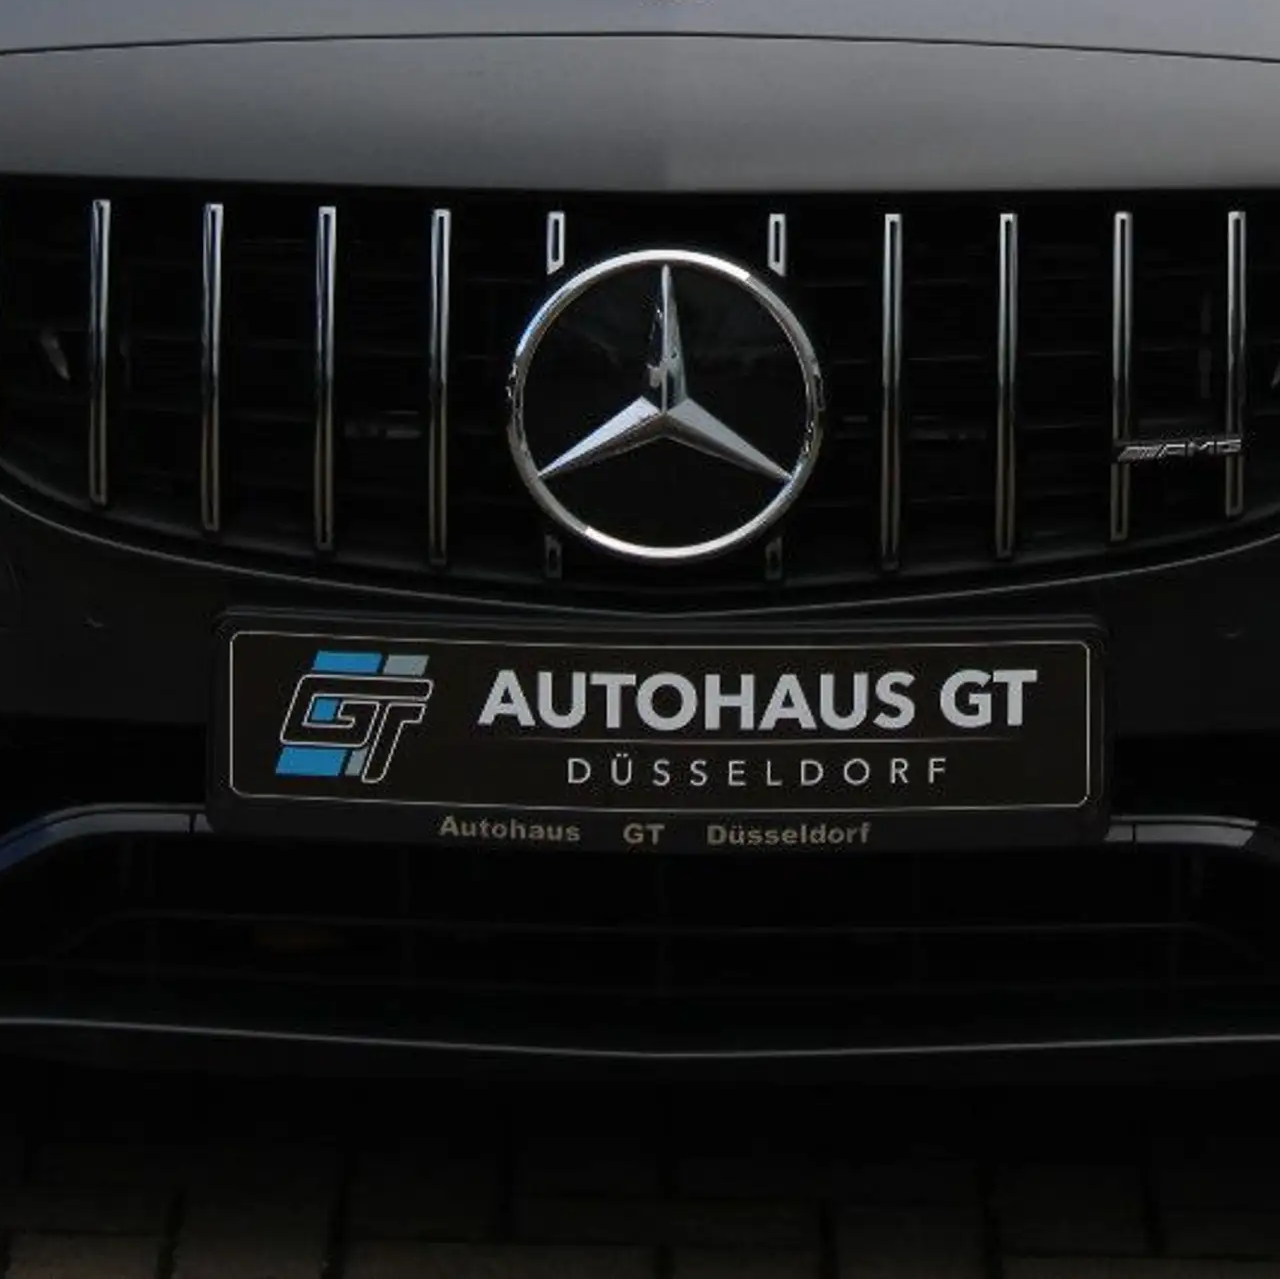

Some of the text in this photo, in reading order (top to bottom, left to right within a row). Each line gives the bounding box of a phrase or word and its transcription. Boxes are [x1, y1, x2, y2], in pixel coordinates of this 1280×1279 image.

[1156, 438, 1242, 459] AMG
[477, 669, 1039, 732] AUTOHAUS GT
[567, 752, 947, 787] DÜSSELDORF
[439, 815, 871, 846] Autohaus GT Düsseldorf
